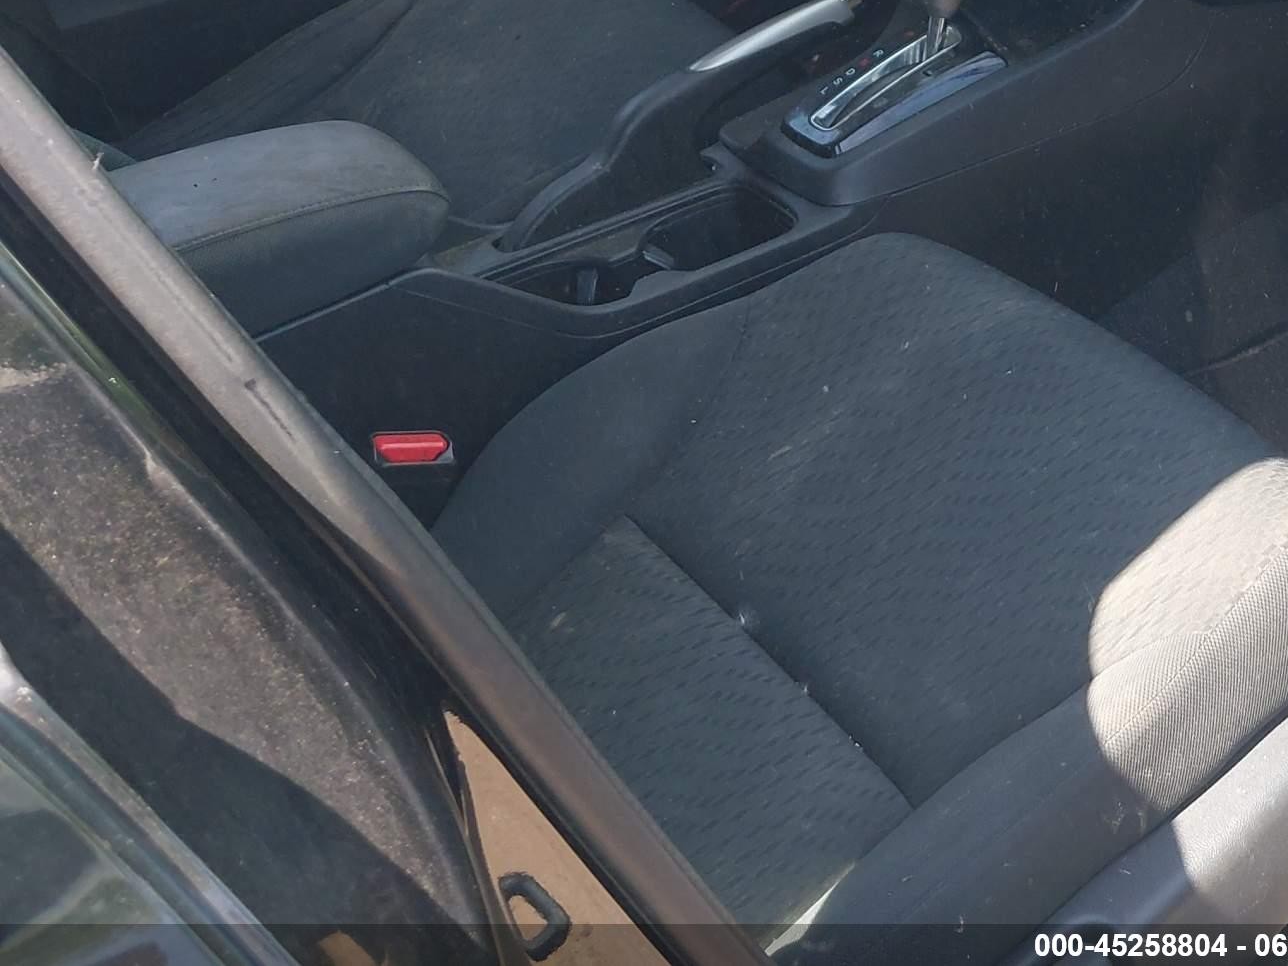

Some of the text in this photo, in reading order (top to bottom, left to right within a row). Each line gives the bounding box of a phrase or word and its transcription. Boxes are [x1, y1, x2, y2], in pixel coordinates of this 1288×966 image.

[873, 49, 884, 58] R
[845, 67, 856, 76] D
[833, 77, 843, 85] S
[820, 86, 829, 95] L
